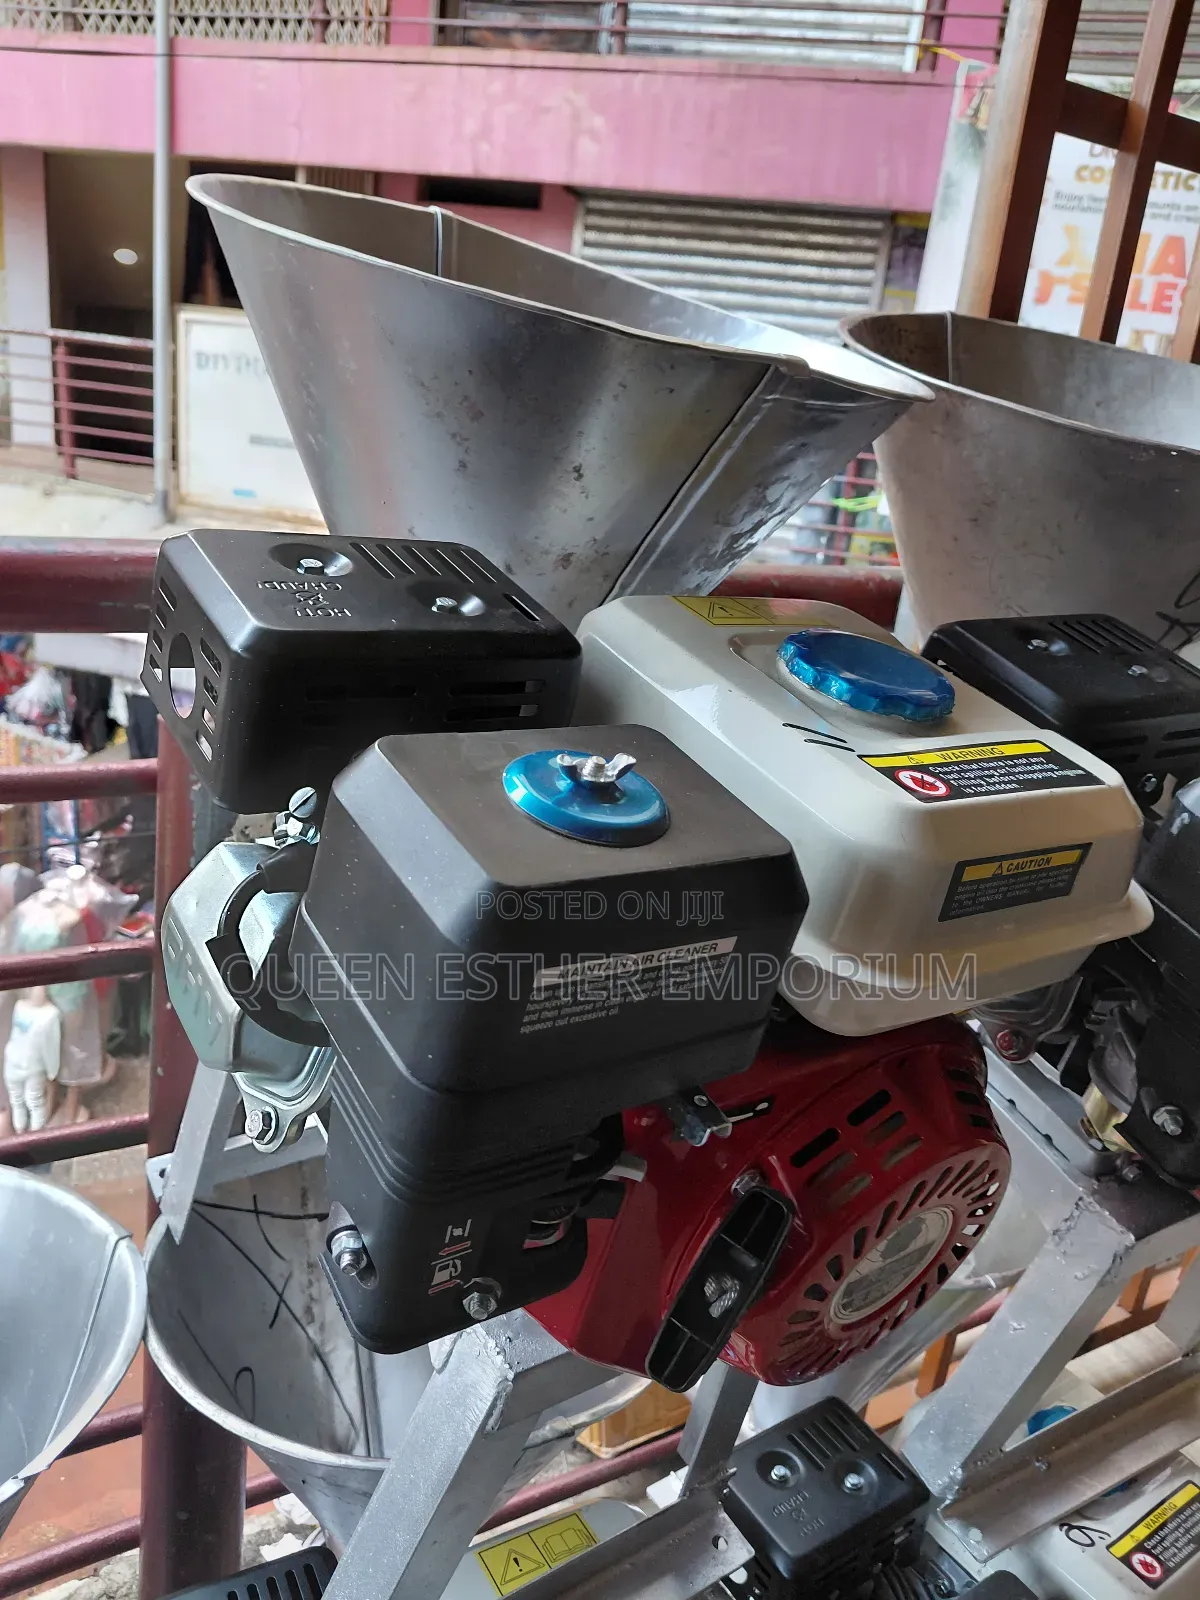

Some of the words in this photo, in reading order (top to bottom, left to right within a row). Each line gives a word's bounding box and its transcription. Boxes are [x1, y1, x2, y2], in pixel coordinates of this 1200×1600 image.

[295, 607, 352, 617] HOT!
[936, 747, 1005, 761] WARNING
[929, 763, 962, 773] Check
[959, 761, 980, 770] that
[978, 759, 1005, 769] there
[1028, 756, 1046, 764] any
[939, 772, 962, 780] fuel
[983, 775, 1016, 783] before
[1014, 771, 1058, 780] stopping
[960, 786, 974, 794] is
[1006, 857, 1052, 873] CAUTION
[957, 883, 977, 893] Before
[558, 959, 630, 979] MAINTAIN
[632, 954, 654, 968] AIR
[657, 943, 719, 963] CLEANER
[522, 1011, 540, 1023] and
[560, 1002, 595, 1016] immerse
[520, 1020, 554, 1035] squeeze
[554, 1016, 569, 1027] out
[570, 1009, 608, 1024] excessive
[1142, 1501, 1178, 1531] WARNING
